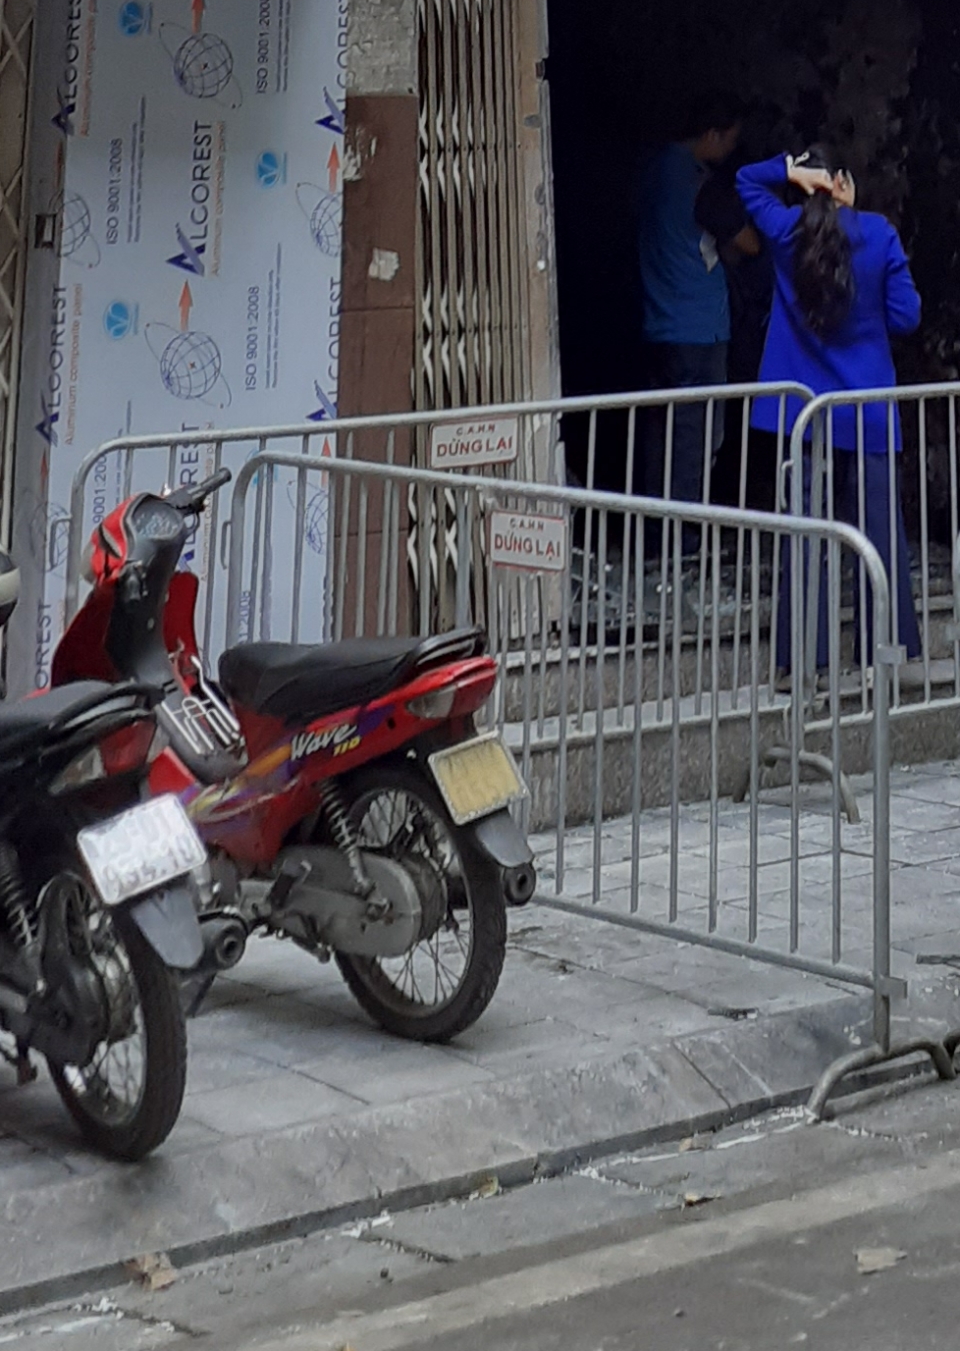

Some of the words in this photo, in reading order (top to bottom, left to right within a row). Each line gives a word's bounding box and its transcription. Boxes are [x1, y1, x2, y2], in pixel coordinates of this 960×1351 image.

[165, 120, 212, 277] ALCOREST
[106, 216, 119, 244] ISO
[245, 363, 257, 391] ISO
[291, 723, 358, 761] Wave
